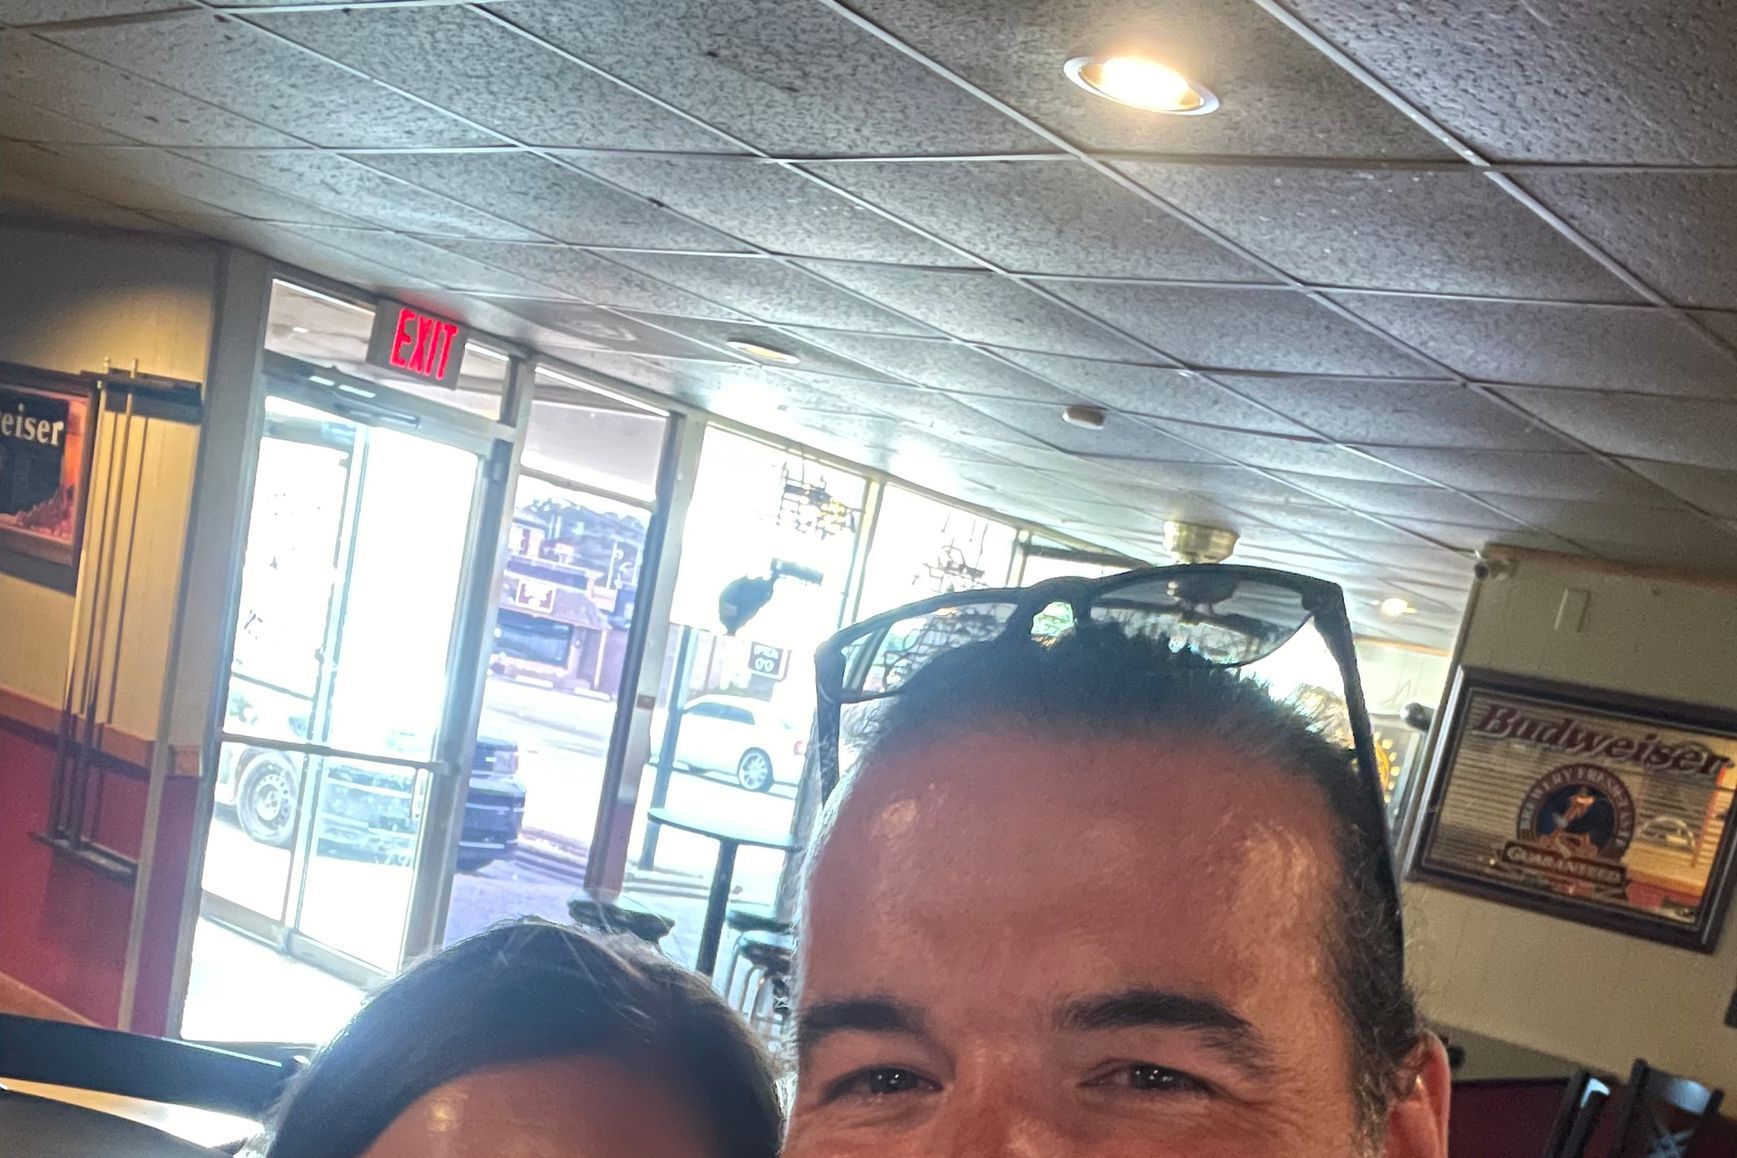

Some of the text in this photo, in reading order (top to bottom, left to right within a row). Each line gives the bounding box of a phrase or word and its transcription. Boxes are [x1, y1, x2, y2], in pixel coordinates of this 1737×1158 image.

[390, 308, 459, 380] EXIT
[0, 403, 64, 446] eiser
[1477, 703, 1734, 775] Budweiser
